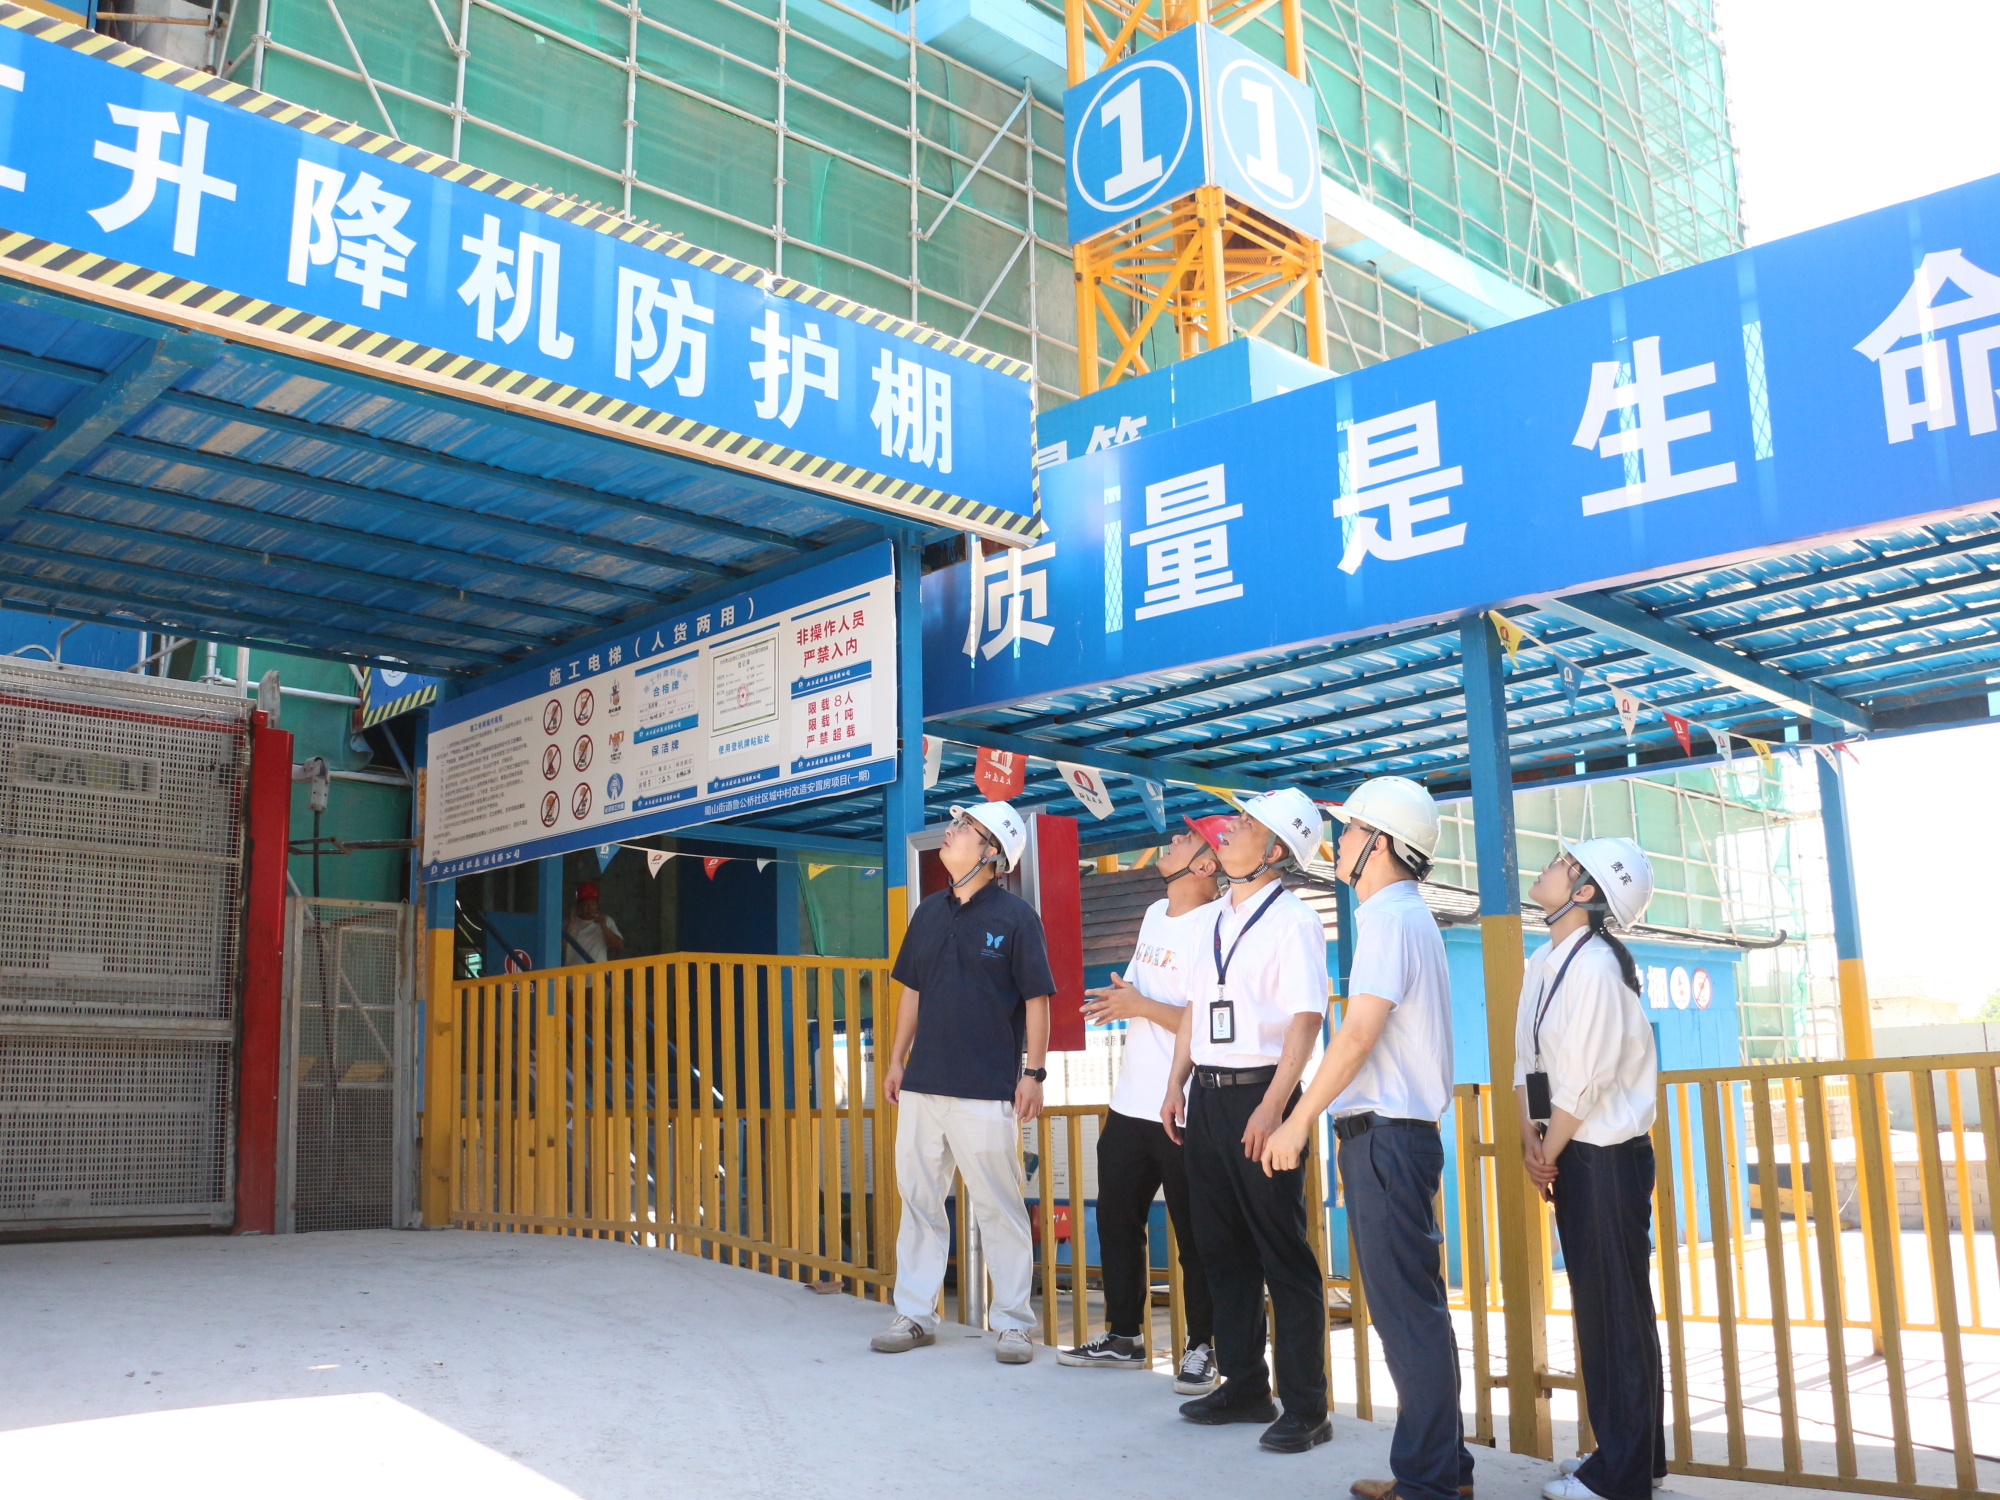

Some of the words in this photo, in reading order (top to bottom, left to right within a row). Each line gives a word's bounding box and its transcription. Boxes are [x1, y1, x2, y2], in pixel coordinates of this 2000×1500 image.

[0, 62, 953, 475] 升降机防护棚
[796, 610, 865, 646] 非操作人员
[803, 637, 858, 668] 严禁入内
[653, 680, 679, 698] 合格牌
[808, 691, 854, 715] 限载8人
[808, 707, 854, 732] 限载1吨
[651, 739, 679, 757] 保洁牌
[806, 723, 856, 749] 严禁超载
[1291, 817, 1312, 839] 贵宾
[1610, 861, 1633, 886] 贵宾
